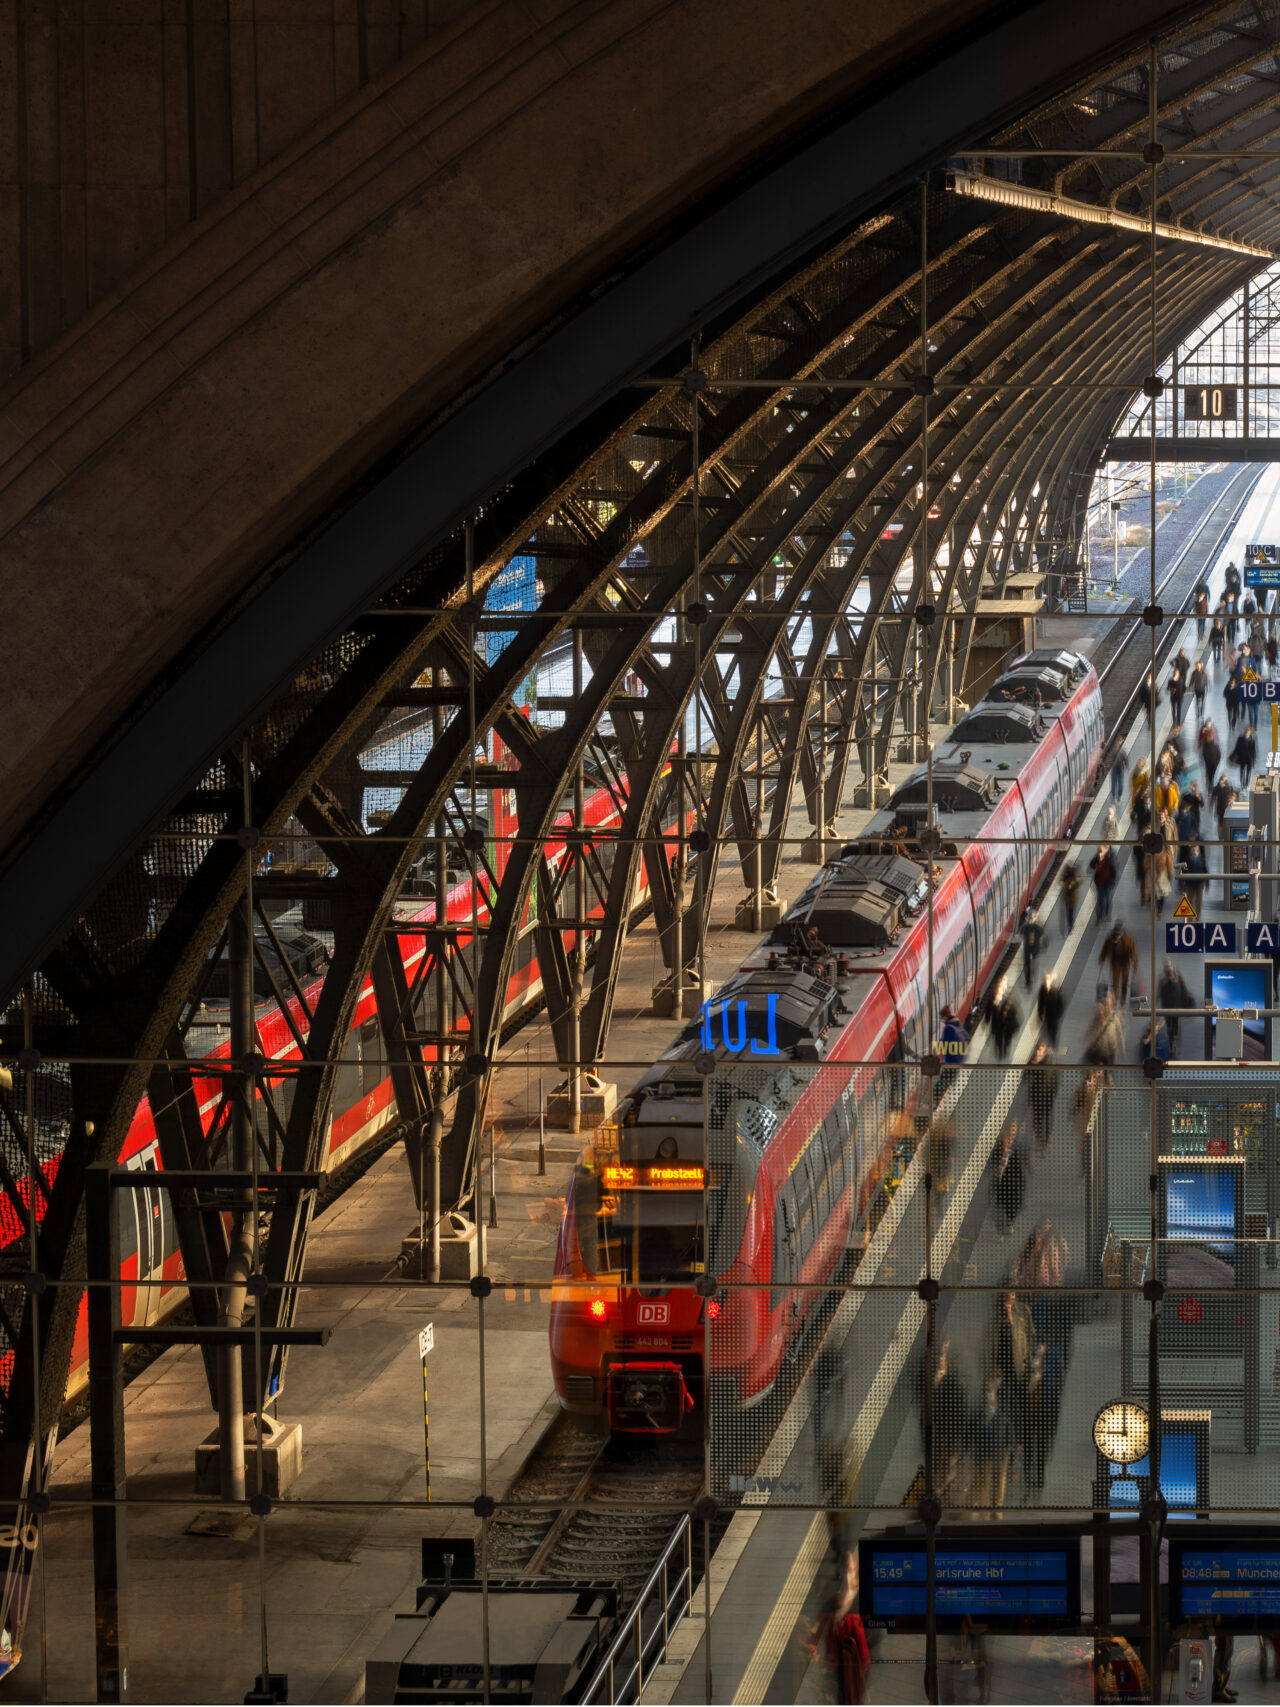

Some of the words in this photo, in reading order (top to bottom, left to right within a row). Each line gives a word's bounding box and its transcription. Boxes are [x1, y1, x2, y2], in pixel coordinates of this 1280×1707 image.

[1200, 389, 1222, 416] 10
[1264, 545, 1272, 555] C
[1240, 682, 1258, 698] 10
[1265, 682, 1276, 698] B
[1169, 924, 1197, 947] 10
[1209, 924, 1228, 946] A
[1255, 924, 1274, 947] A
[651, 1168, 704, 1179] Probstzell
[641, 1306, 667, 1322] DB
[873, 1567, 903, 1579] 15:49
[935, 1567, 982, 1579] arlsruhe
[985, 1567, 1004, 1579] Hbf
[1182, 1568, 1212, 1579] 08:48
